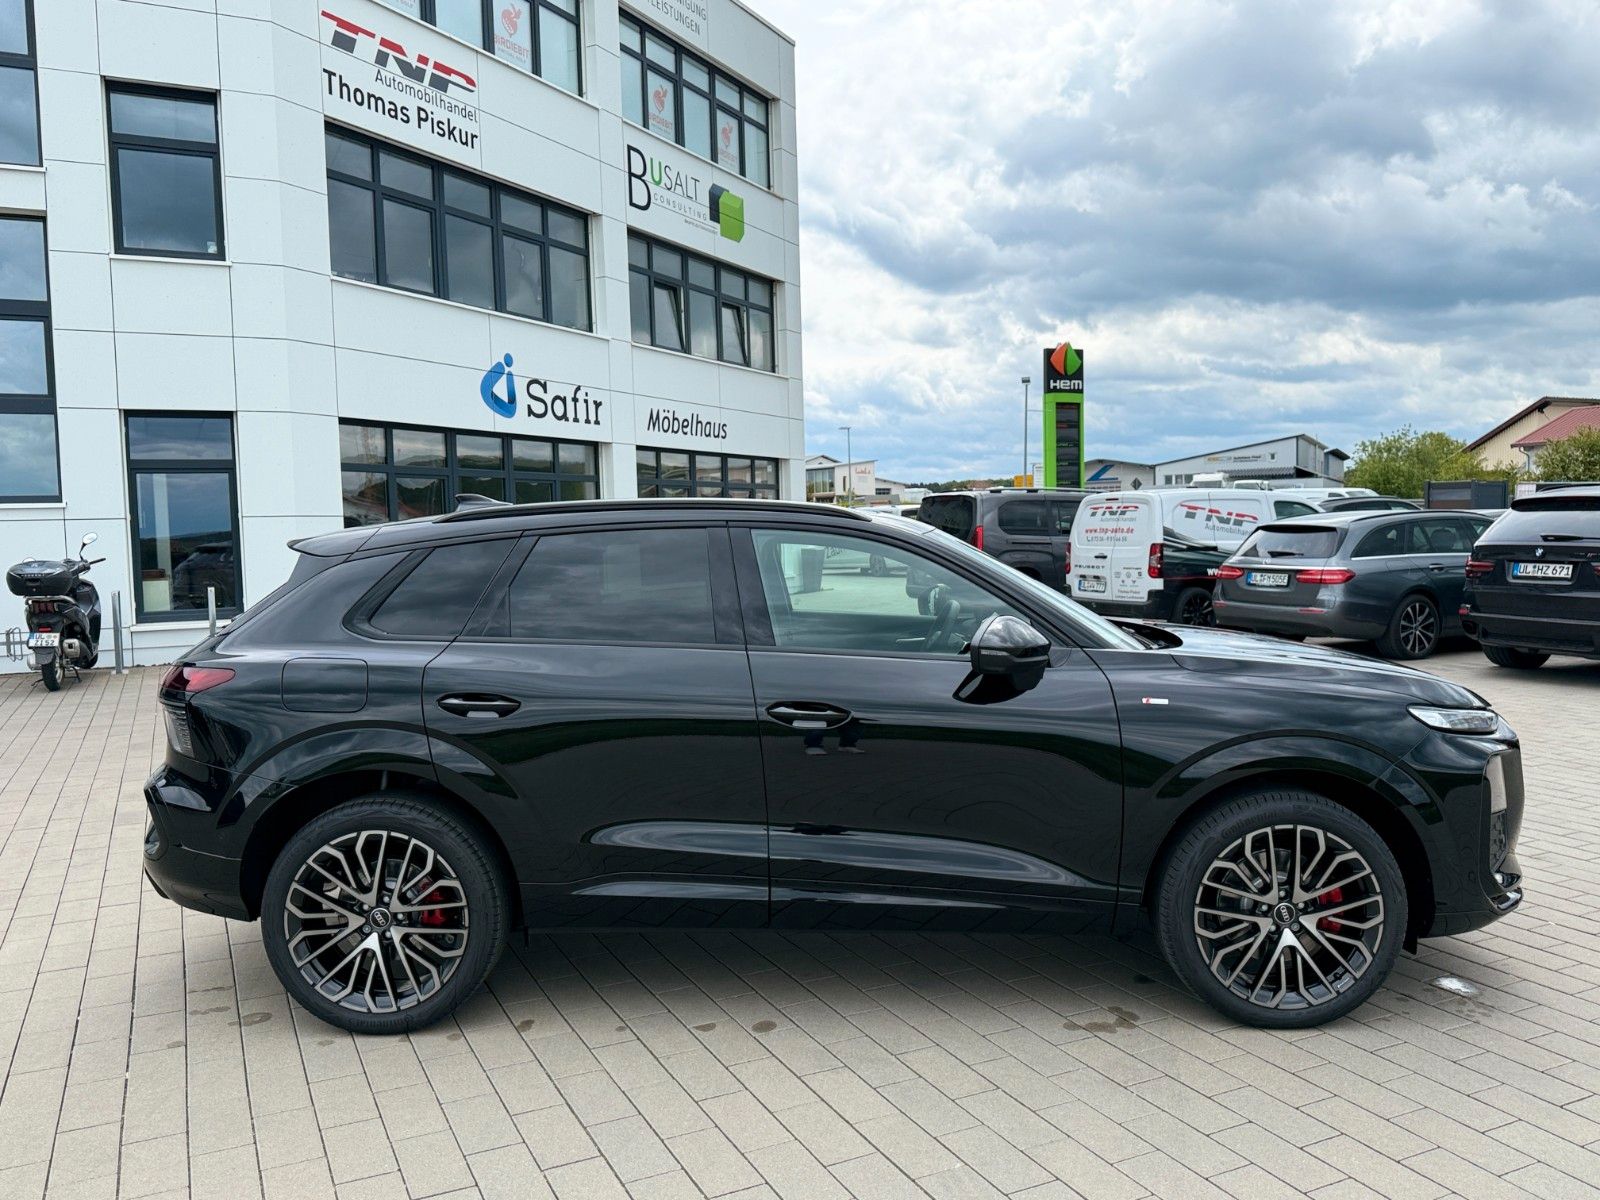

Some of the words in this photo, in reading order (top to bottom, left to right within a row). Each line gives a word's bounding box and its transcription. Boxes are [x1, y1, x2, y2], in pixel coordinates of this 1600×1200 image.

[648, 0, 700, 35] LEISTUNGEN
[321, 10, 476, 93] TNP
[322, 68, 410, 124] Thomas
[417, 106, 478, 149] Piskur
[375, 69, 478, 123] Automobilhandel
[653, 192, 707, 221] CONSULTING
[526, 378, 602, 425] Safir
[647, 408, 727, 439] Möbelhaus
[1090, 505, 1139, 517] TNP
[1180, 503, 1258, 526] TNP
[1205, 523, 1249, 536] Automobilhan
[1519, 563, 1531, 574] UL
[1536, 564, 1550, 575] HZ
[1552, 565, 1570, 576] 671
